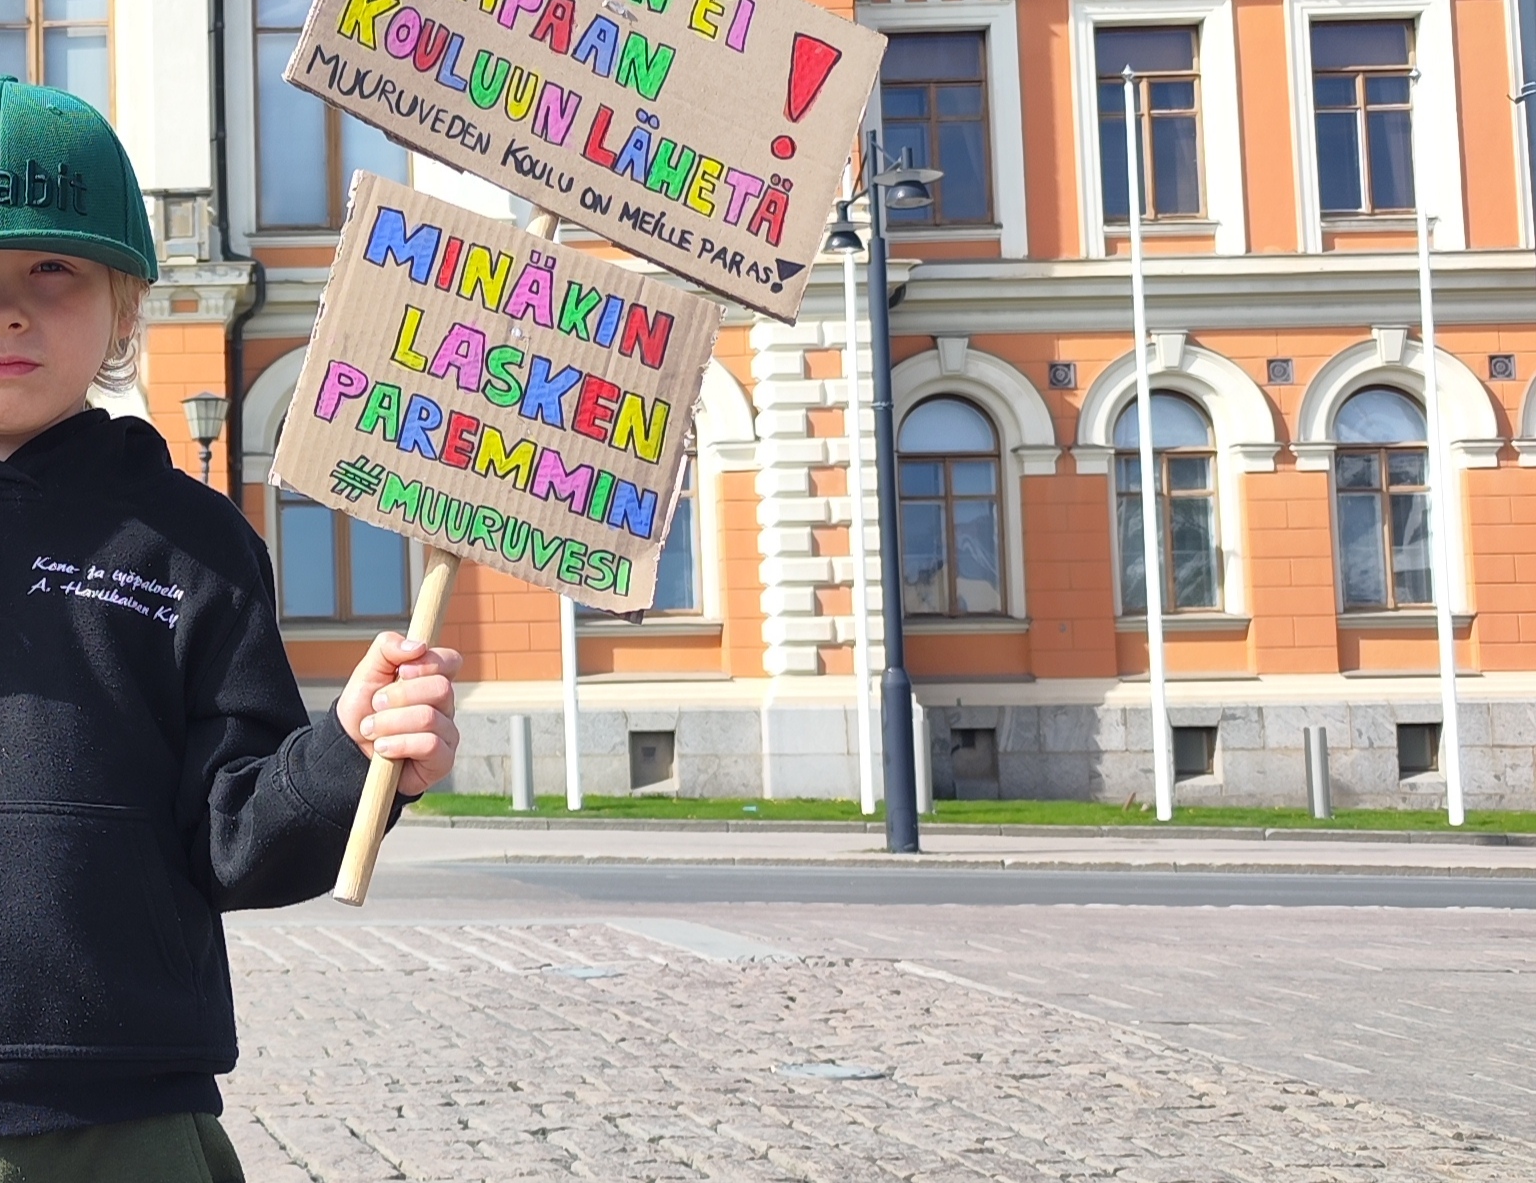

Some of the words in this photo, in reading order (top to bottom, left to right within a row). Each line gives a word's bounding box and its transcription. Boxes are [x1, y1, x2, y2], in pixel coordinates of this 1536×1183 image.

[306, 44, 491, 155] MUURUVEDEN
[500, 138, 574, 193] KOULU
[580, 186, 612, 215] ON
[579, 104, 793, 247] LÄHETÄ
[363, 205, 674, 369] MINÄKIN
[314, 360, 659, 539] PAREMMIN
[390, 304, 670, 465] LASKEN
[32, 556, 80, 574] Kone-
[87, 565, 105, 580] ja
[330, 456, 632, 597] #MUURUVESI
[153, 605, 179, 629] Ky
